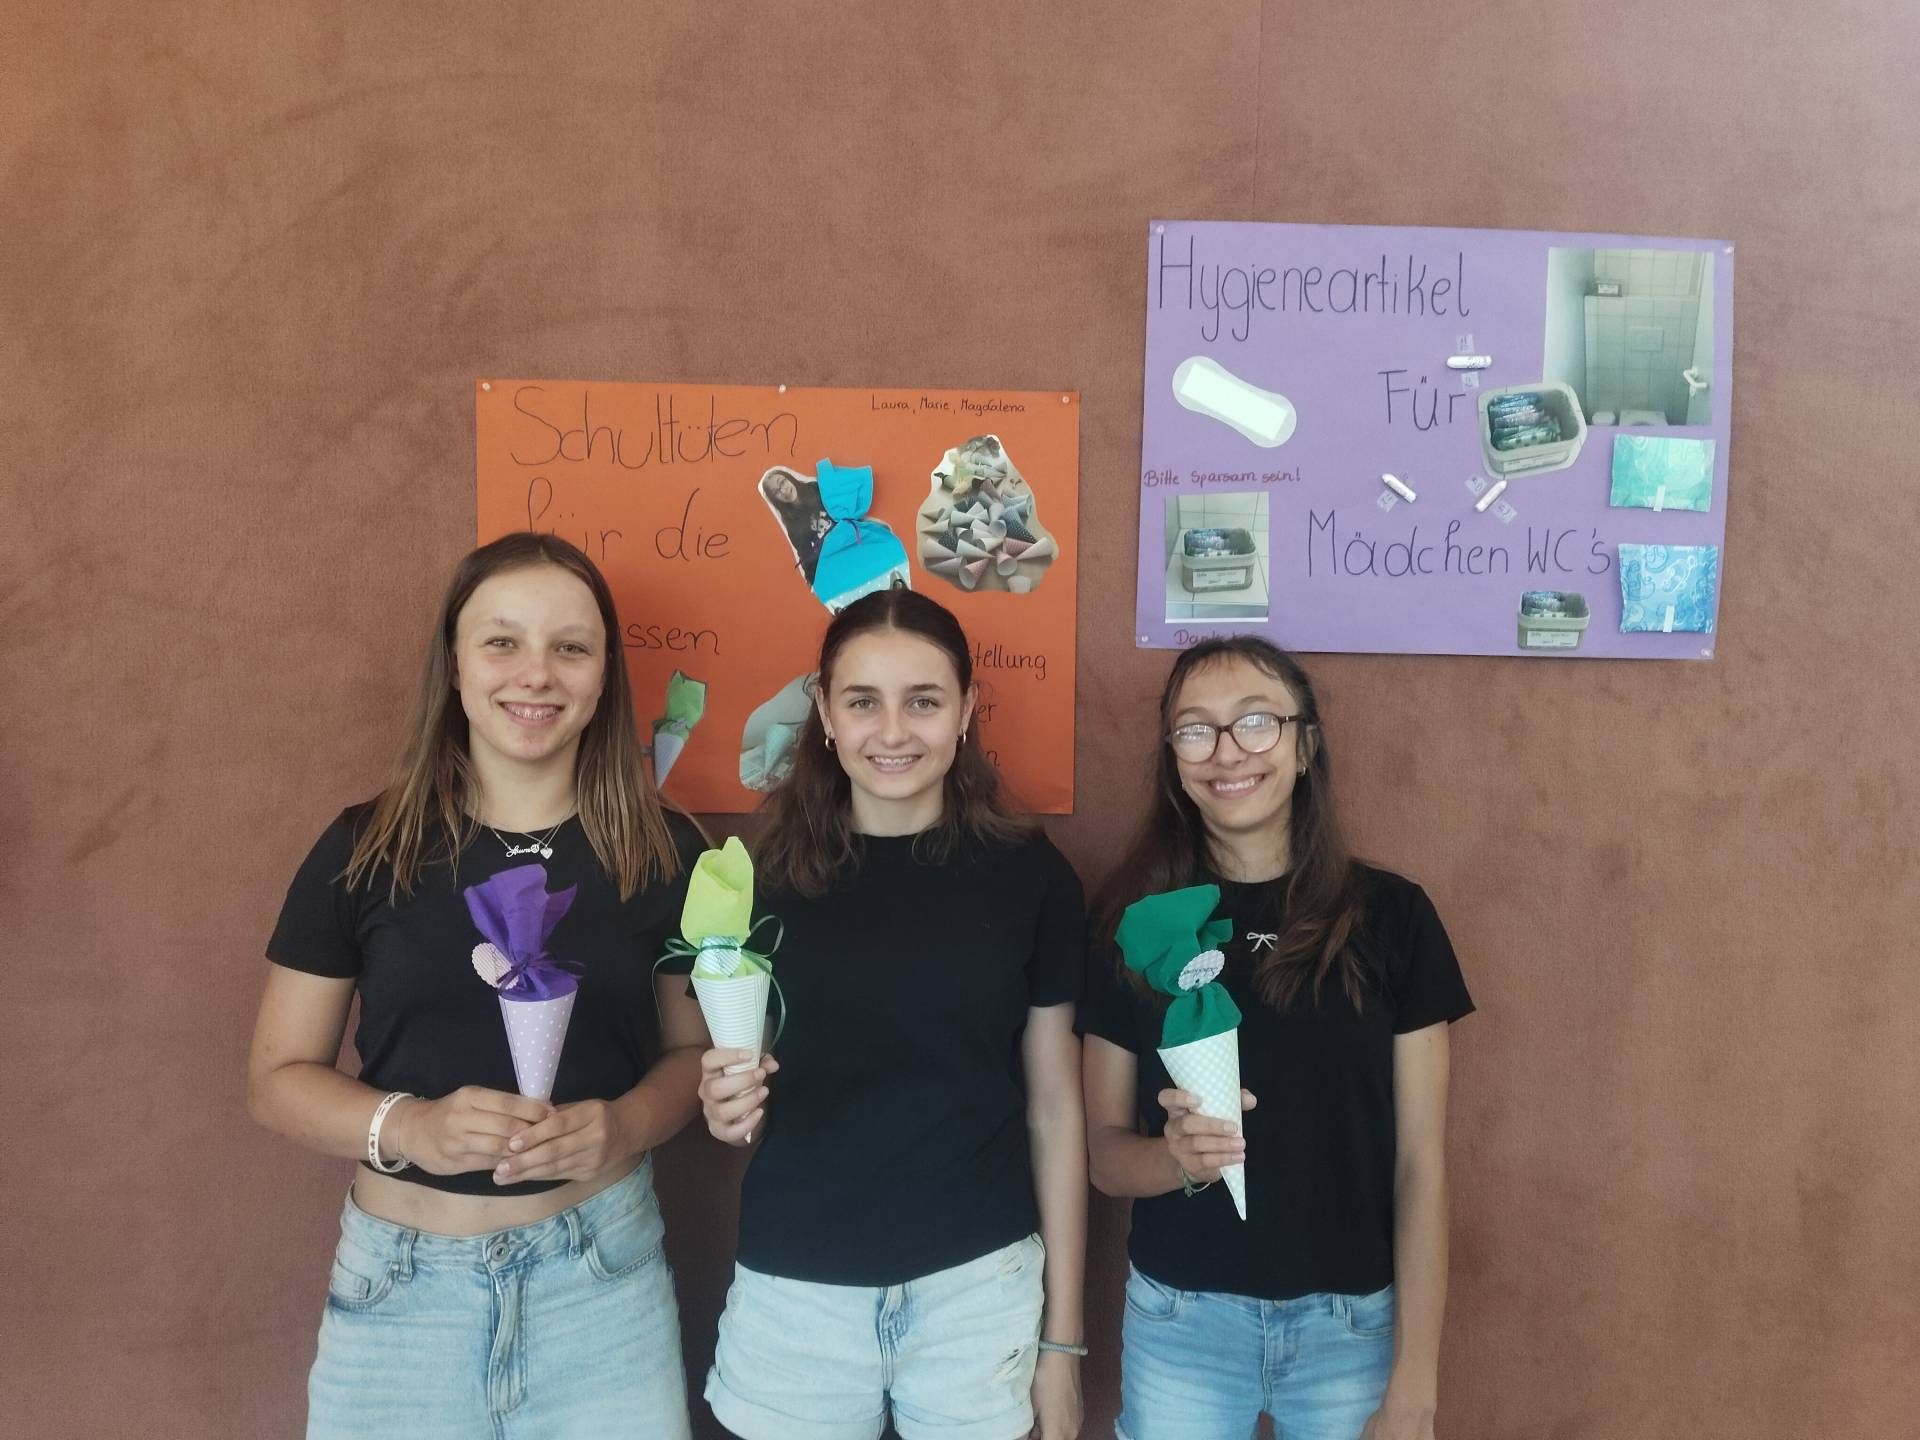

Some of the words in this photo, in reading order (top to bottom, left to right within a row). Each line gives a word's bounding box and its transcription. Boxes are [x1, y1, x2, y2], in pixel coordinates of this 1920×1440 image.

[1158, 234, 1470, 342] Hygieneartikel
[511, 386, 798, 469] Schultüten
[871, 394, 916, 415] Laura,
[919, 395, 957, 415] Marie,
[960, 398, 1026, 417] Magdalena
[1378, 370, 1467, 431] Für
[1143, 468, 1181, 487] Bitte
[1262, 465, 1303, 483] sein!
[655, 487, 731, 562] die
[1308, 509, 1510, 577] Mädchen
[623, 623, 721, 656] ssen
